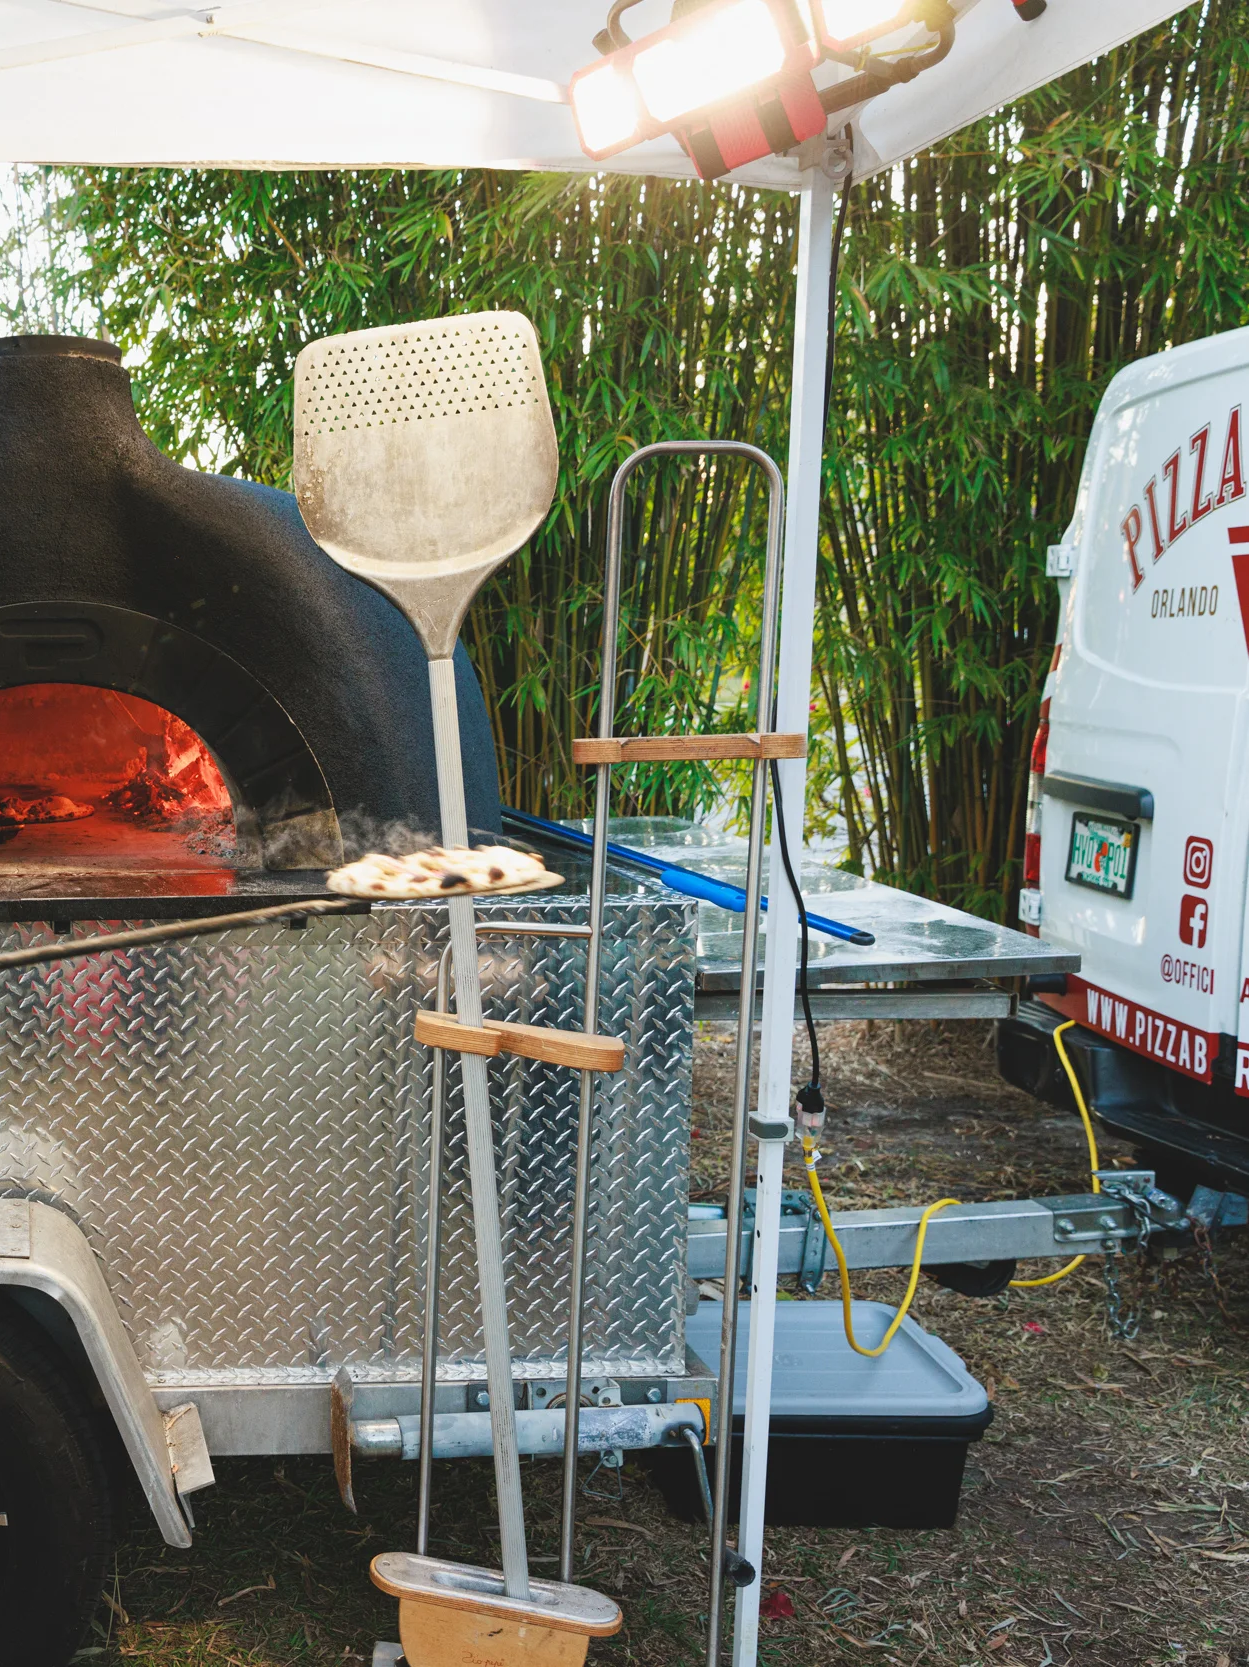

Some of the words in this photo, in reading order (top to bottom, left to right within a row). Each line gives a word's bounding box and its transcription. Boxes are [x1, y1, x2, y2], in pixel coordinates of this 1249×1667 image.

[1120, 403, 1246, 594] PIZZA
[1151, 585, 1219, 619] ORLANDO
[1161, 954, 1215, 996] @OFFICI
[1087, 988, 1209, 1075] WWW.PIZZAB
